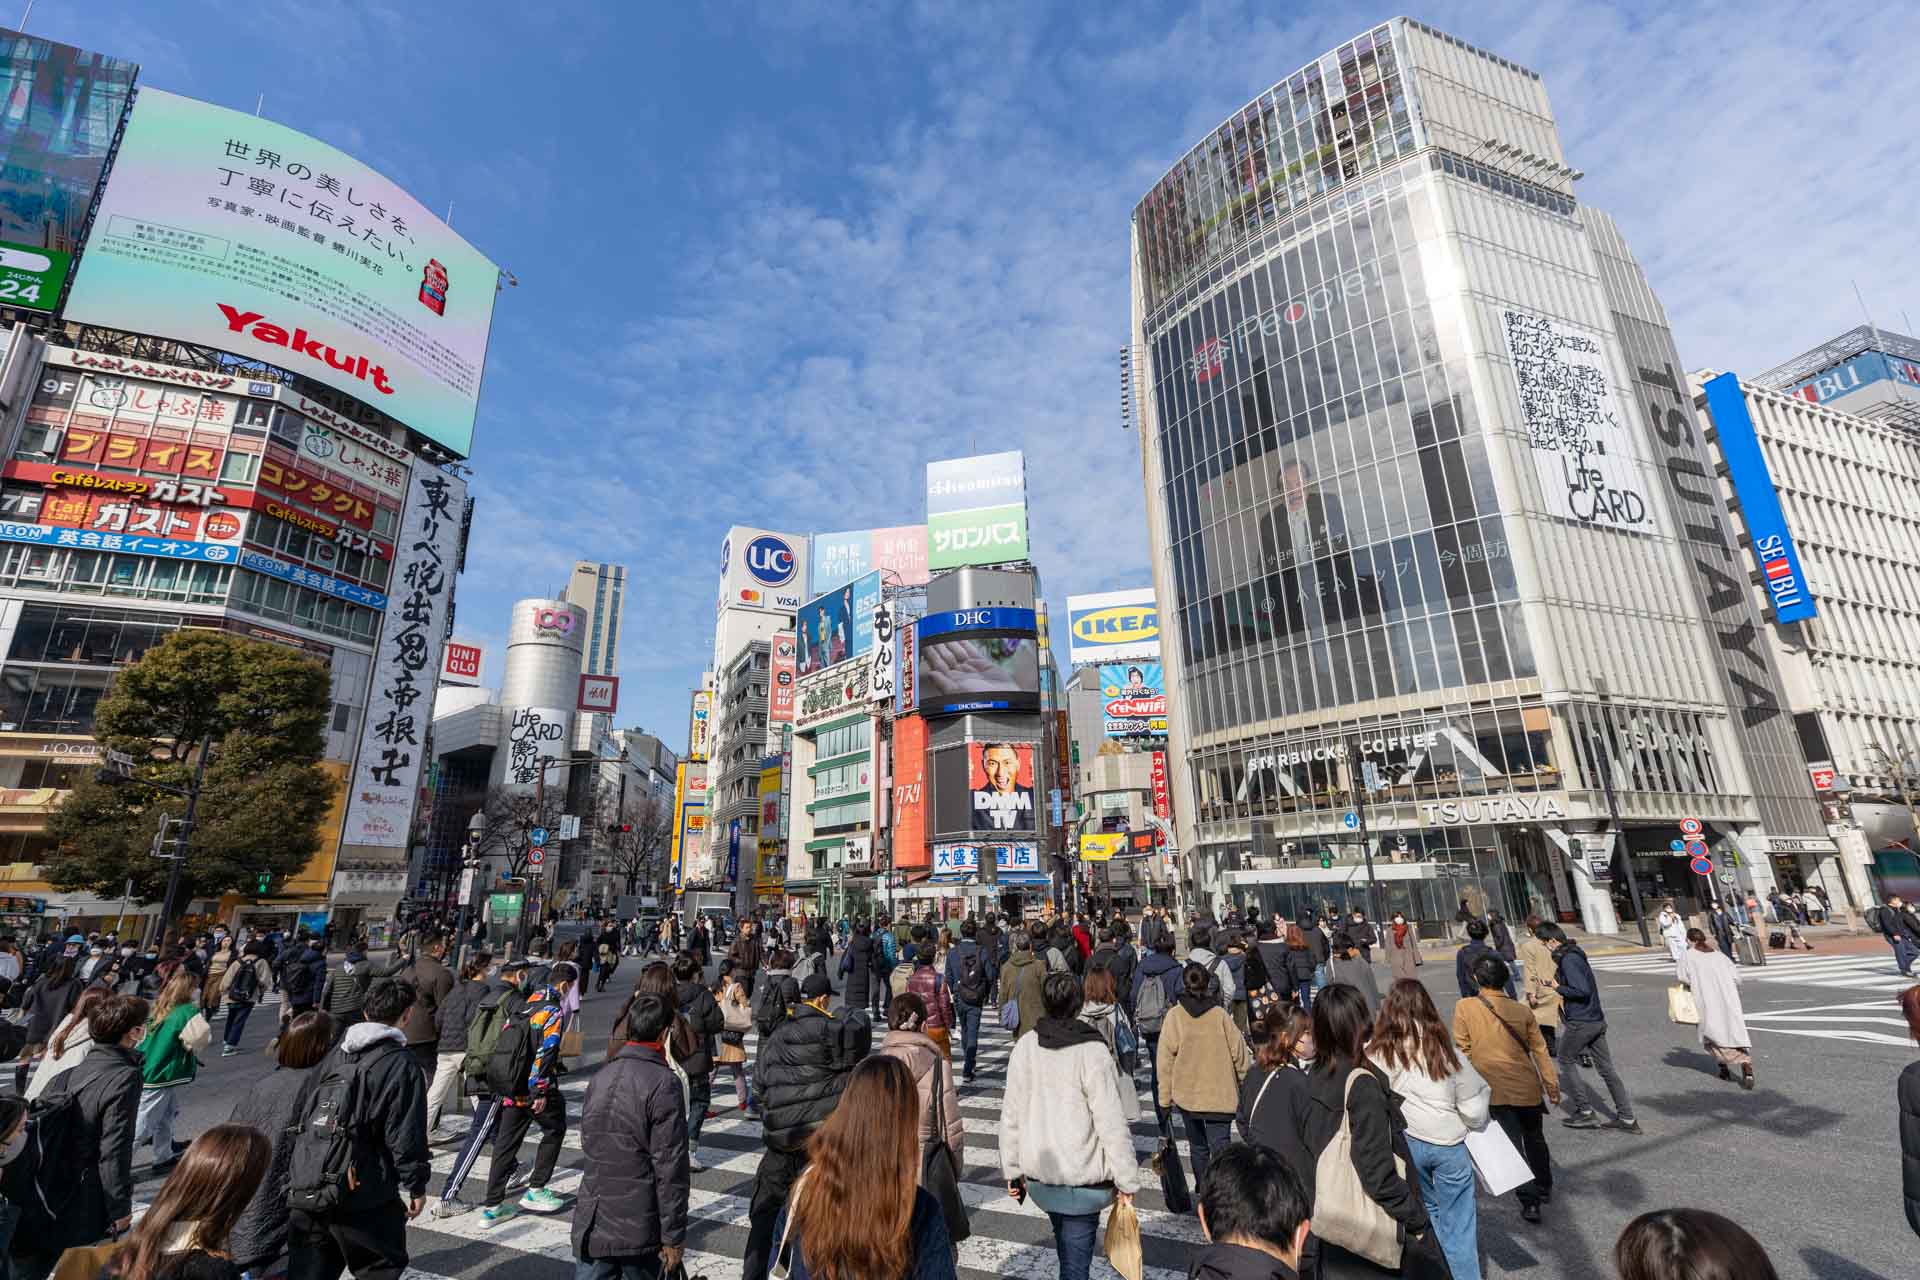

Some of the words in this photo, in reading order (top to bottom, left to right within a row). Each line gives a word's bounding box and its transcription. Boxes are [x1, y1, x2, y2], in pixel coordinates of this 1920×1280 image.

[225, 139, 415, 245] 世界の美しさを、
[218, 167, 413, 272] 丁寧に伝えたい。
[217, 302, 394, 395] Yakult
[71, 350, 235, 388] しゃぶしゃぶバイキング
[42, 379, 74, 394] 9F
[132, 389, 226, 421] しゃぶ葉
[67, 432, 215, 472] プライス
[338, 441, 401, 487] しゃぶ葉
[1562, 450, 1605, 493] Life
[1, 494, 40, 513] 7F
[151, 479, 225, 506] ガスト
[260, 461, 371, 519] コンタクト
[92, 502, 190, 536] ガスト
[207, 523, 237, 534] ガスト
[57, 529, 199, 555] 英会話イーオン
[207, 547, 227, 559] 6F
[335, 527, 385, 557] ガスト
[933, 520, 1021, 551] サロンパス
[1637, 362, 1781, 730] TSUTAYA
[751, 545, 792, 574] UC
[1755, 534, 1801, 609] SEIBU
[248, 554, 288, 575] AEON
[292, 564, 386, 607] 英会話イーオン
[776, 596, 799, 607] VISA
[955, 611, 991, 627] DHC
[1081, 614, 1159, 636] IKEA
[452, 647, 476, 661] UNI
[873, 603, 893, 695] もんじゃ
[450, 662, 476, 674] QLO
[588, 687, 609, 699] H&M
[512, 706, 541, 729] Life
[1248, 743, 1348, 771] STARBUCKS
[1360, 732, 1438, 755] COFFEE
[974, 791, 1032, 810] DMM
[1422, 795, 1565, 825] TSUTAYA
[989, 810, 1018, 829] TV
